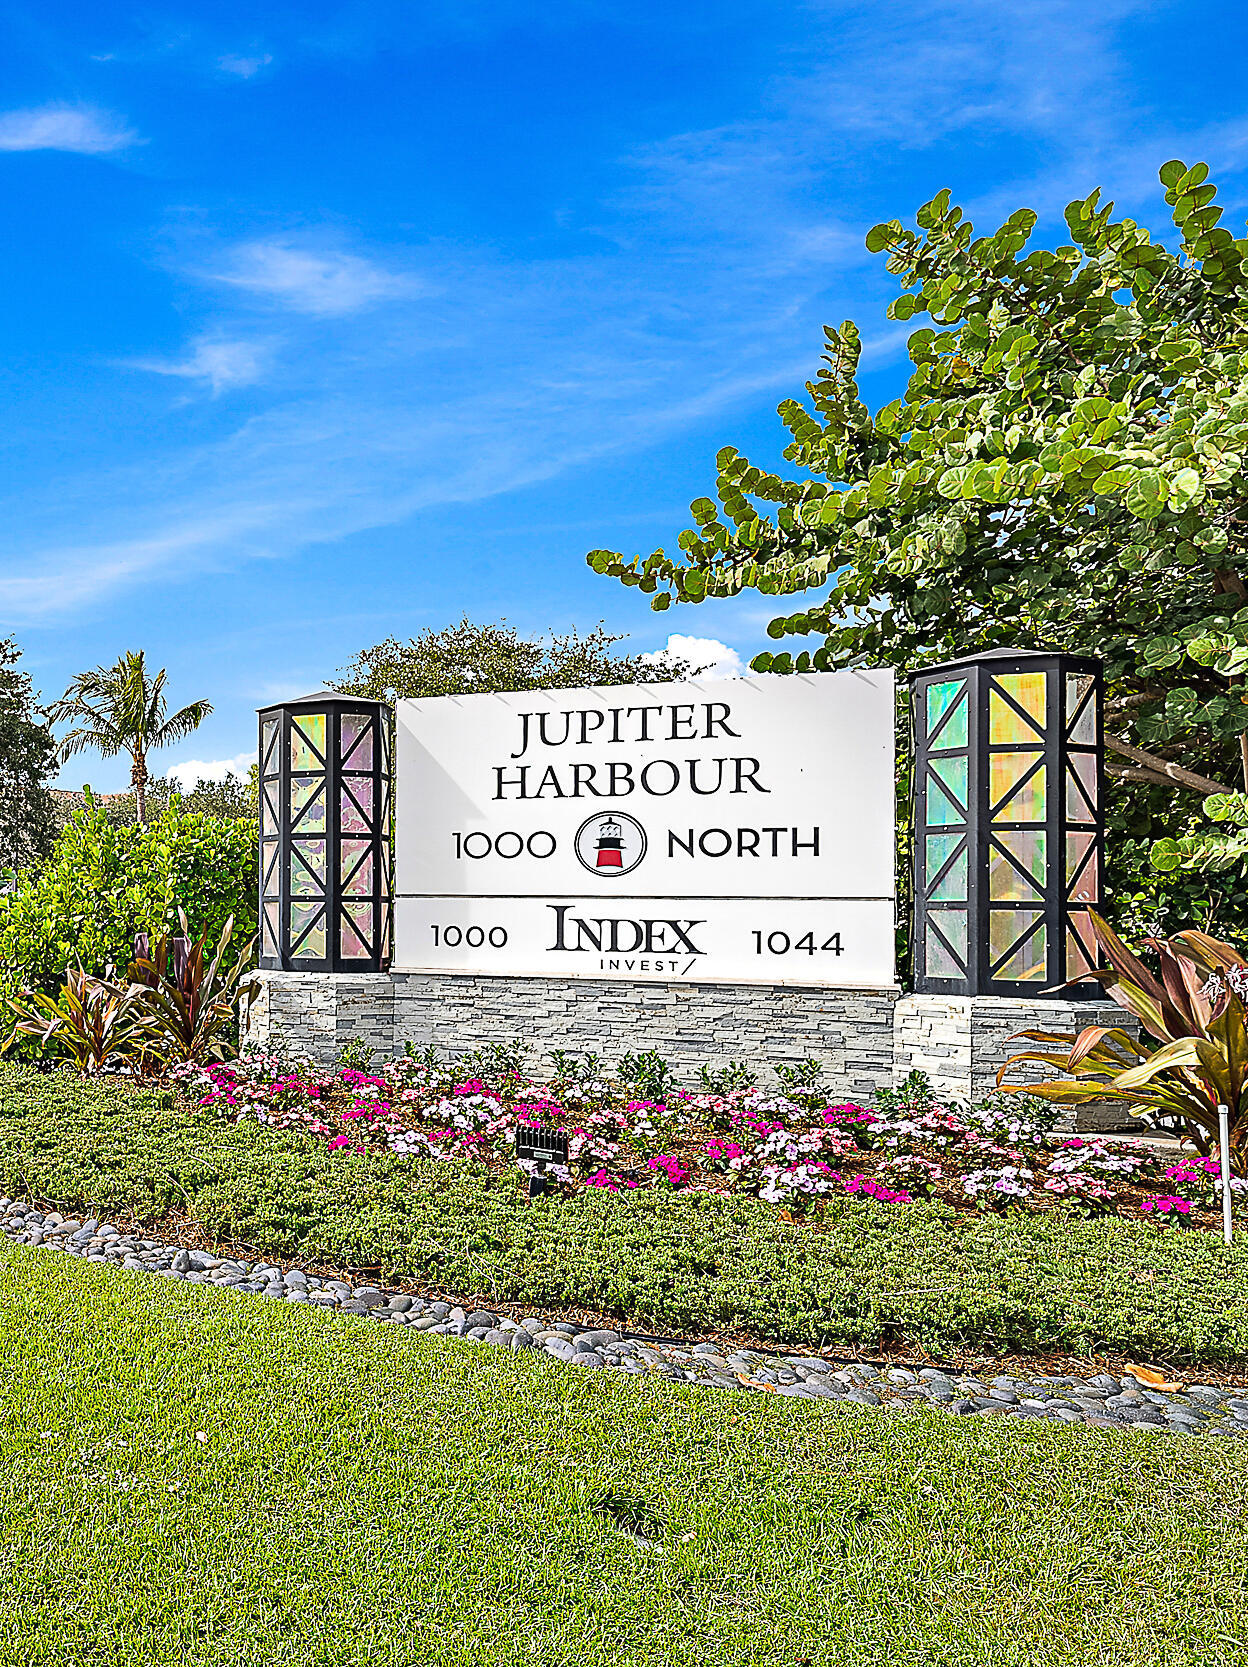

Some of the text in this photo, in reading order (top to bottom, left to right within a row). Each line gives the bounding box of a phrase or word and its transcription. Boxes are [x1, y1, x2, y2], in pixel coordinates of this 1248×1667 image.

[511, 703, 741, 758] JUPITER
[492, 757, 771, 800] HARBOUR
[452, 827, 819, 859] 1000 NORTH
[431, 905, 844, 956] 1000 INDEX 1044
